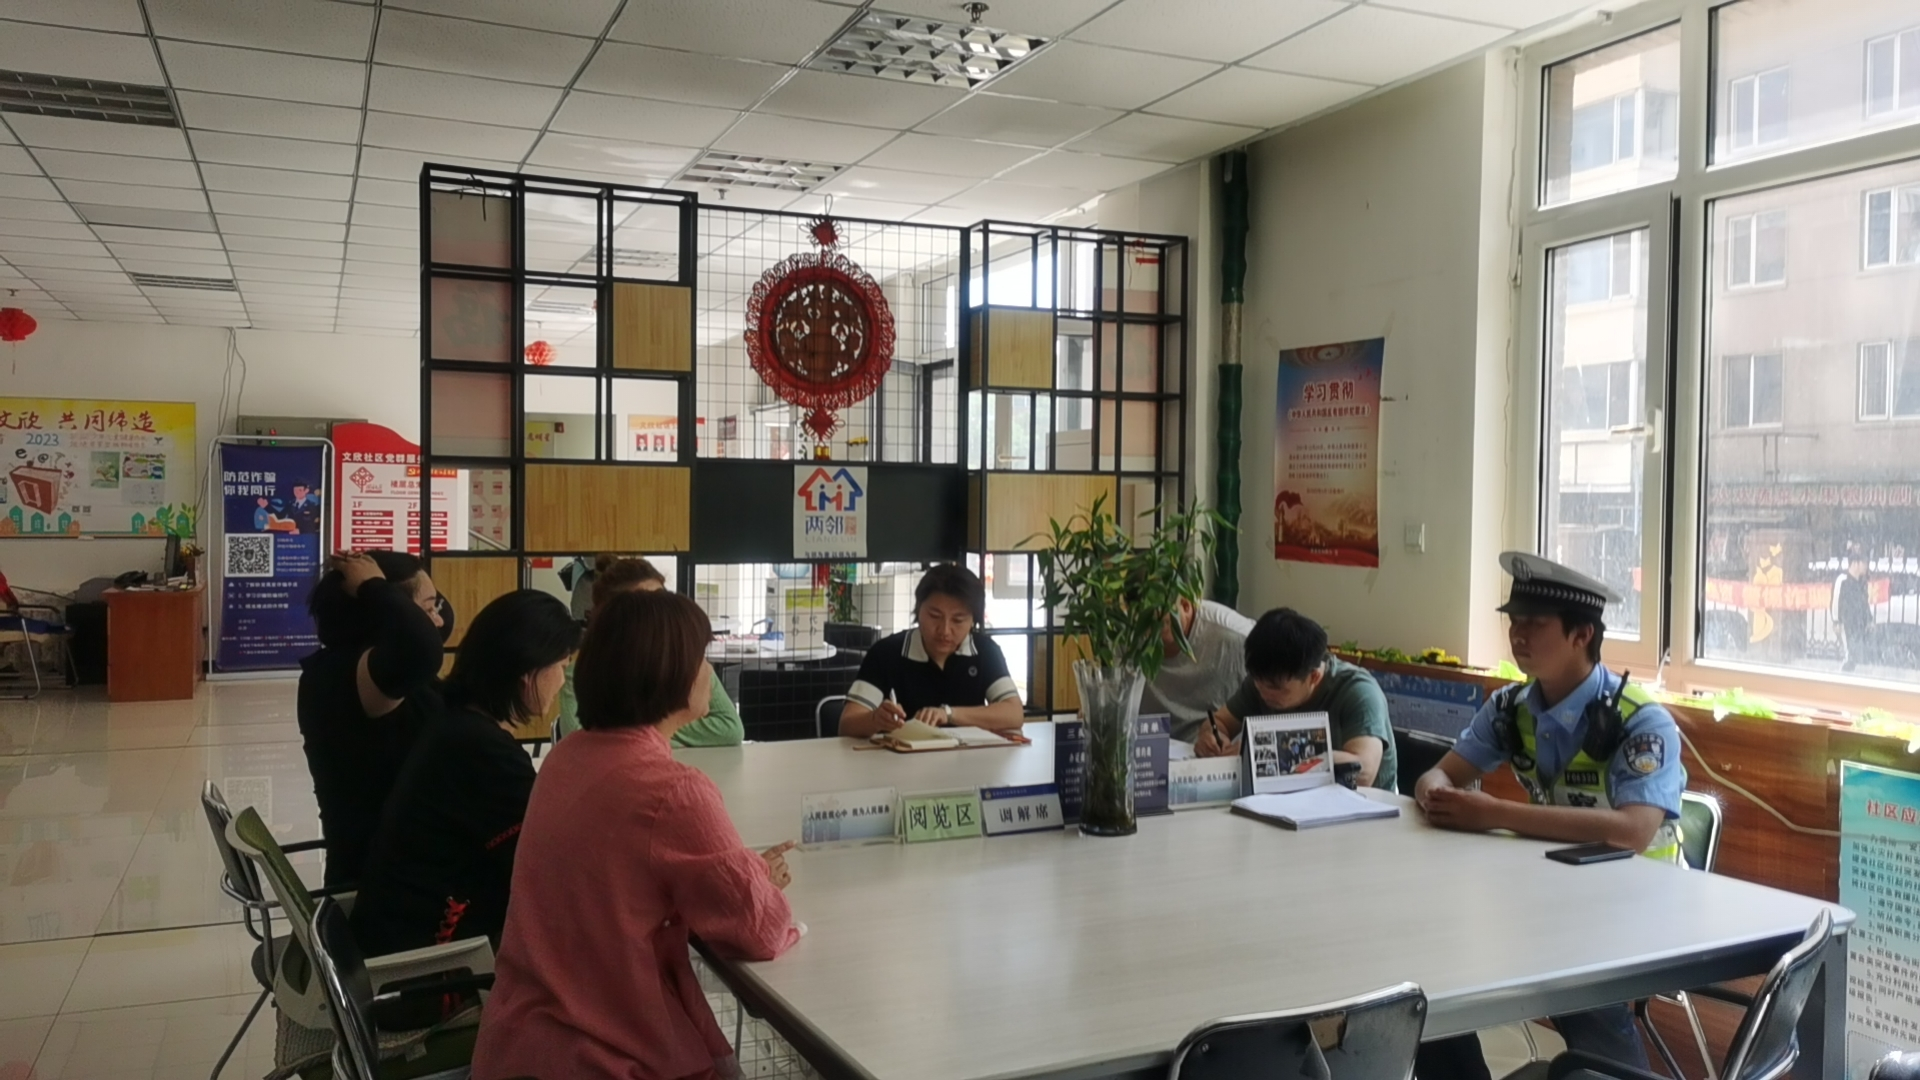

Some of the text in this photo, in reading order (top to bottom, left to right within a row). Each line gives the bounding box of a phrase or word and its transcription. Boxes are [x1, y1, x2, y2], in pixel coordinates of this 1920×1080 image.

[1303, 381, 1354, 403] 学习贯彻
[58, 409, 156, 433] 共同缔造
[26, 433, 59, 446] 2023
[223, 471, 276, 483] 防范诈骗
[223, 484, 276, 496] 你我同行
[805, 515, 843, 535] 两邻
[808, 808, 848, 821] 人民在我心中
[909, 803, 1049, 831] 阅览区 调解席
[1867, 799, 1920, 824] 社区应
[1848, 1011, 1920, 1045] 好突发事件的先期
